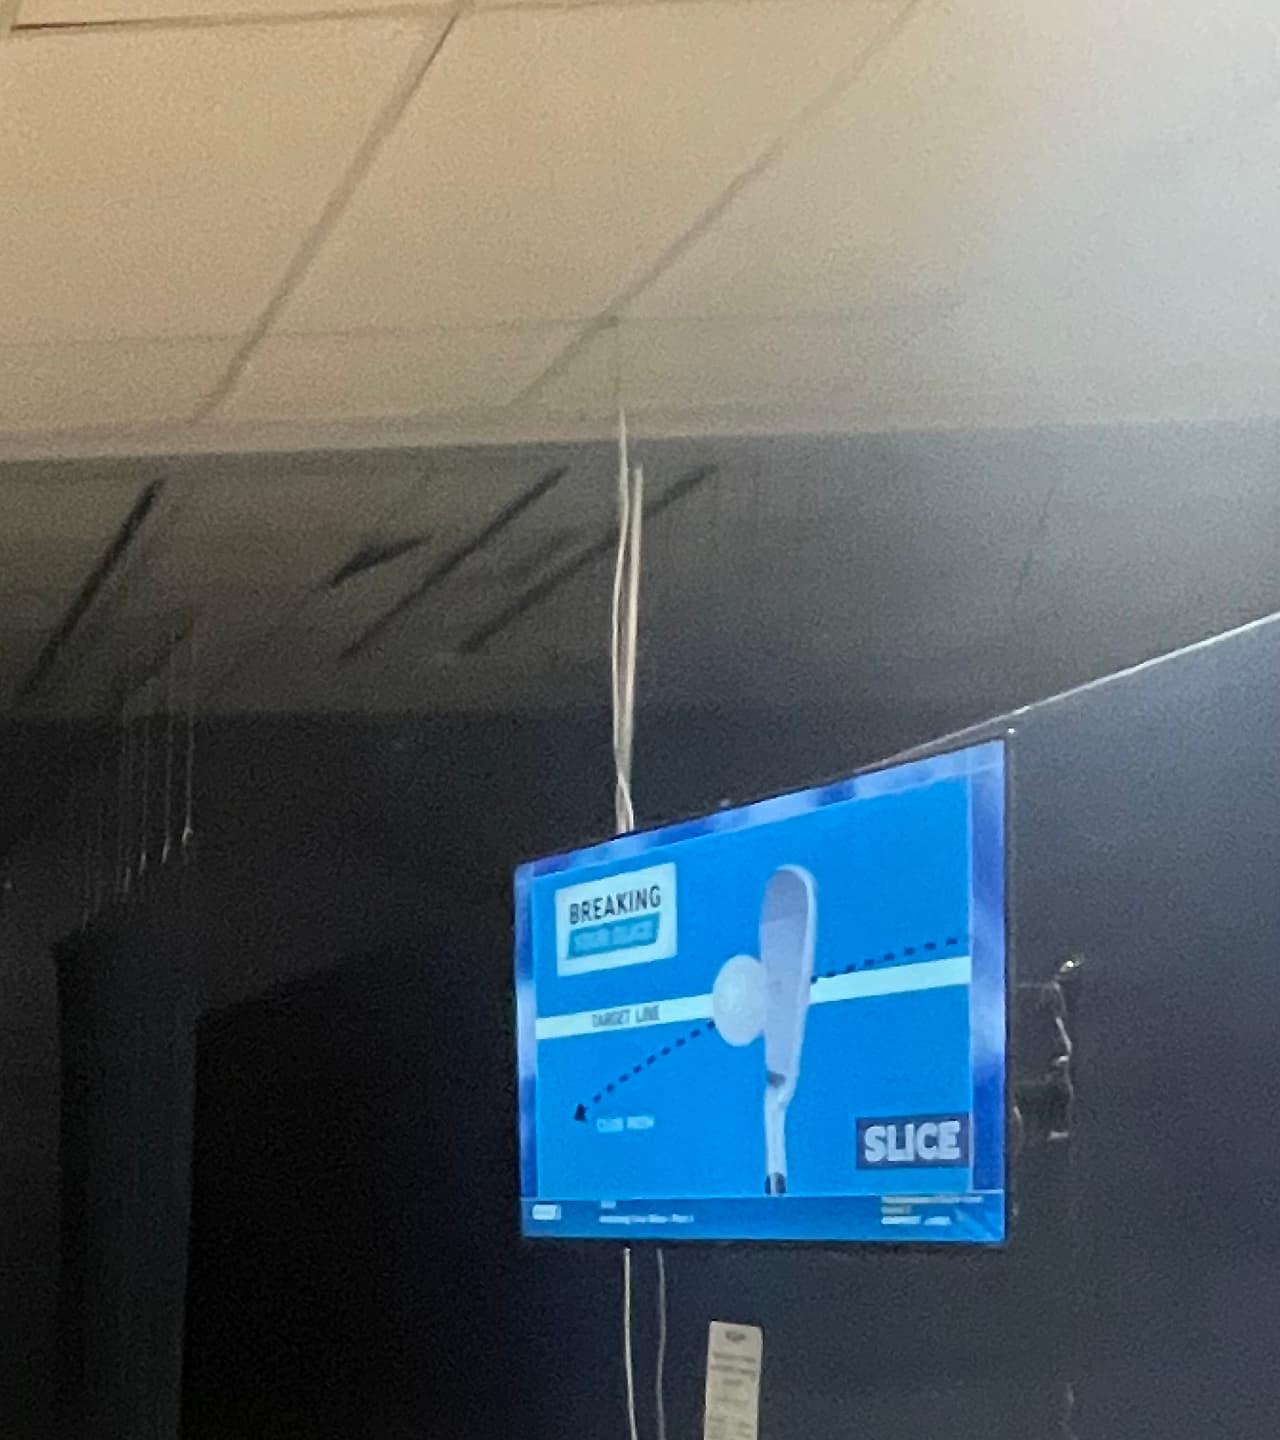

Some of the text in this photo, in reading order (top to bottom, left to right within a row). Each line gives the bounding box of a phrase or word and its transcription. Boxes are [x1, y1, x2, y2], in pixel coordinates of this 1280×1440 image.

[569, 885, 661, 925] BREAKING
[591, 1008, 630, 1028] TARGET
[864, 1120, 961, 1162] SLICE
